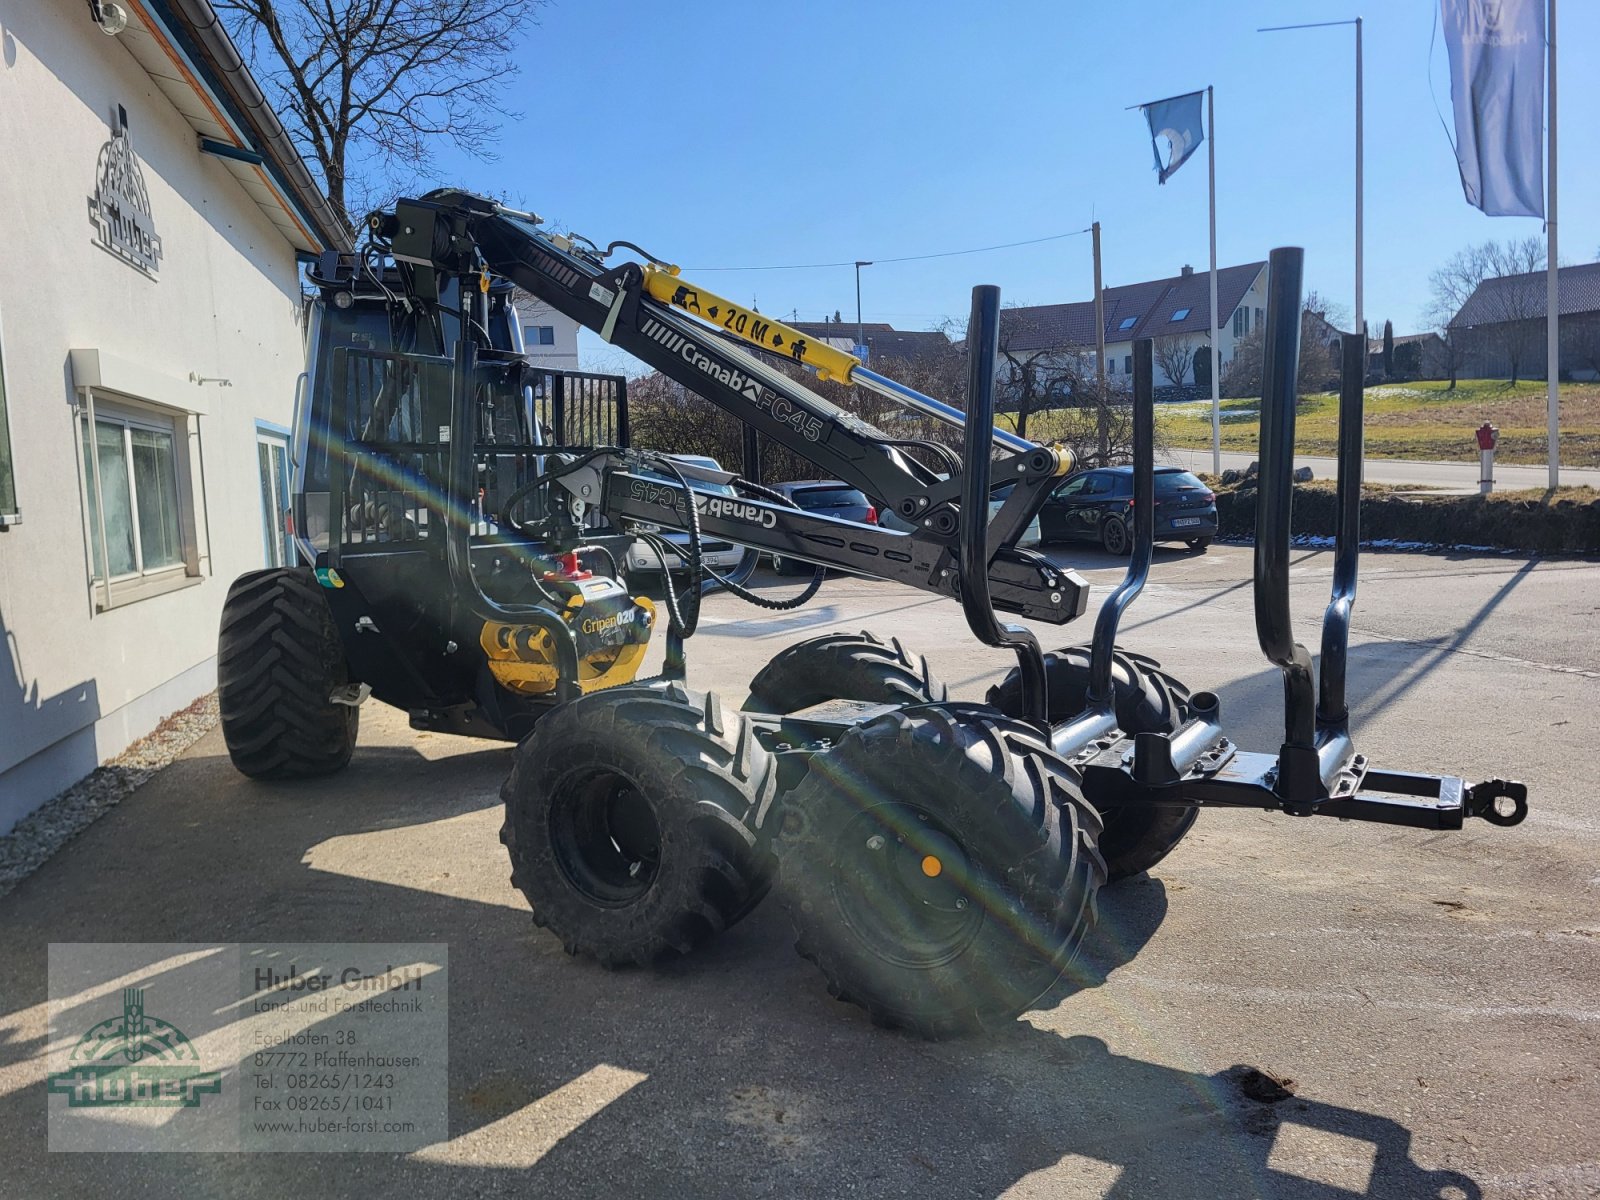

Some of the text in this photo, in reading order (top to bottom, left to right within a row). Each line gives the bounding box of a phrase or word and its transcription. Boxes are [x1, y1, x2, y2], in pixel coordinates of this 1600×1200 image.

[724, 309, 770, 344] 20 M
[681, 343, 824, 442] Cranab FC45
[709, 498, 777, 529] Cranab
[582, 614, 617, 636] Gripen
[616, 608, 635, 626] 020
